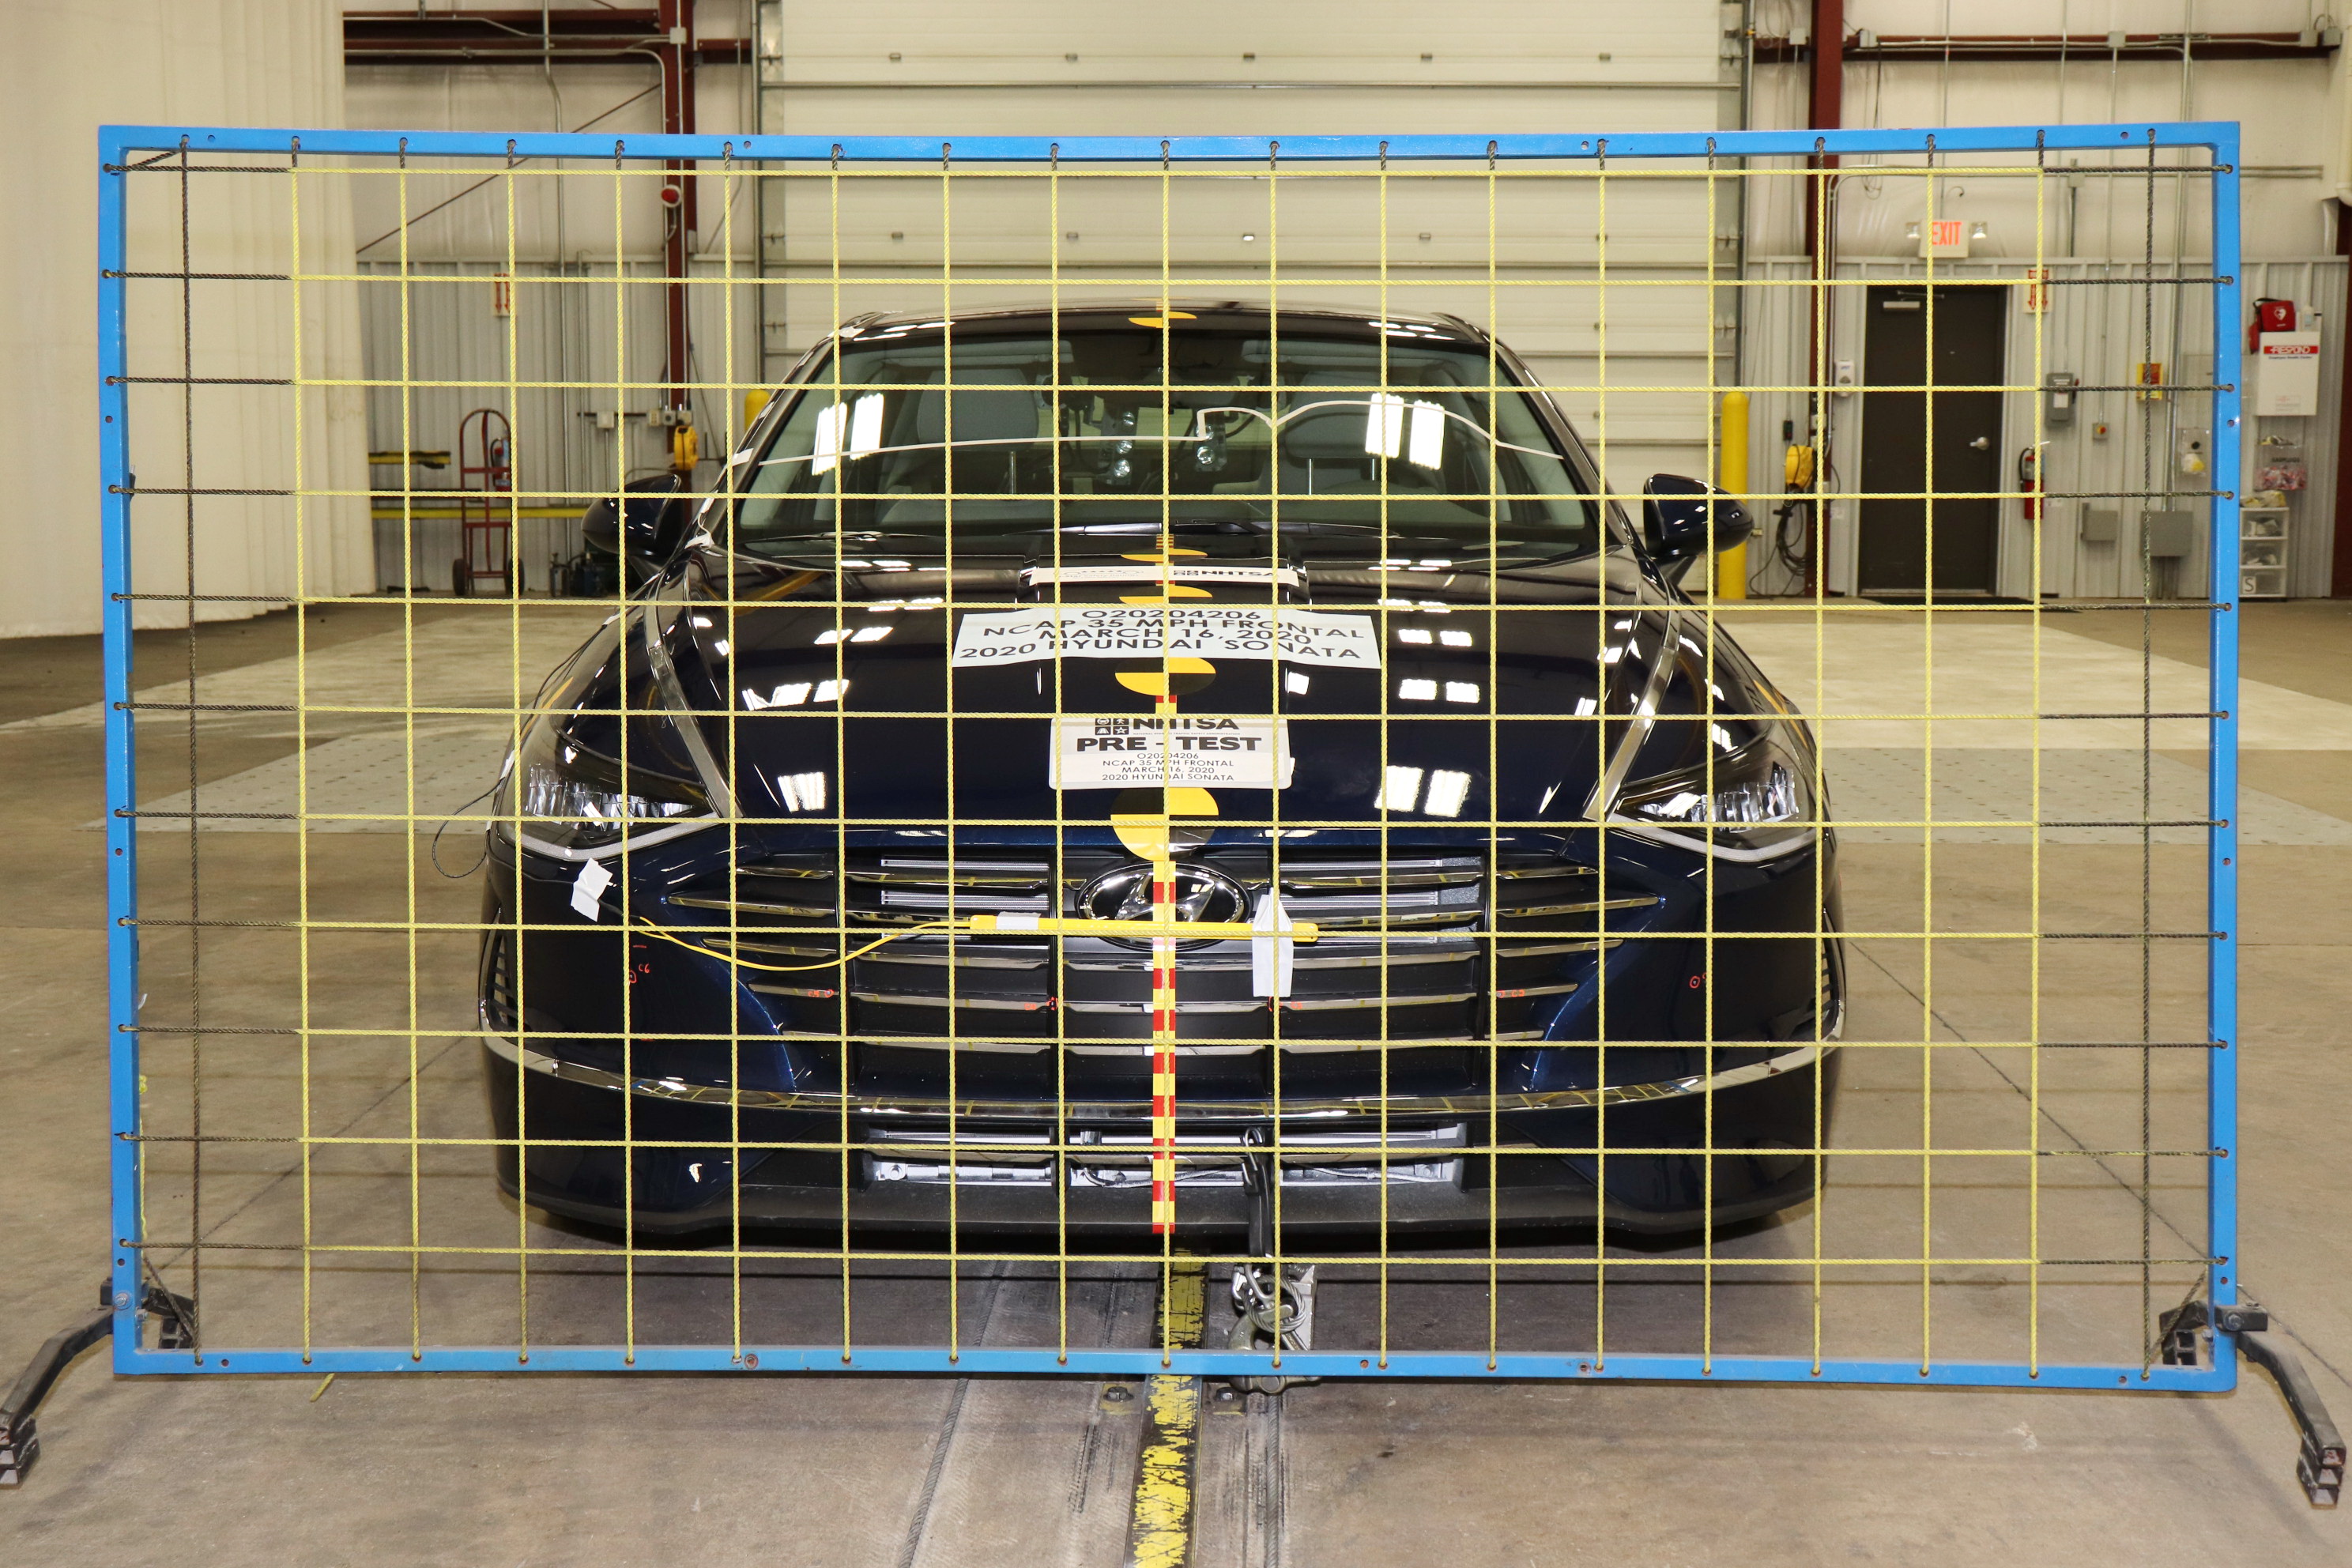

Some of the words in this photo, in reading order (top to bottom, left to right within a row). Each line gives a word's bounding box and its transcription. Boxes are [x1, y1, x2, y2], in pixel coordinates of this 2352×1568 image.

[1932, 221, 1962, 246] EXIT
[2245, 577, 2254, 592] S
[983, 620, 1076, 636] NCAP
[1087, 619, 1124, 628] 35
[1136, 619, 1208, 628] MPH
[1222, 620, 1364, 639] FRONTAL
[1039, 628, 1163, 639] MARCH
[1182, 629, 1223, 639] 16,
[1237, 630, 1312, 645] 2020
[959, 643, 1036, 658] 2020
[1049, 639, 1202, 649] HYUNDAI
[1224, 639, 1361, 658] SONATA
[1077, 737, 1147, 752] PRE
[1175, 737, 1261, 751] TEST
